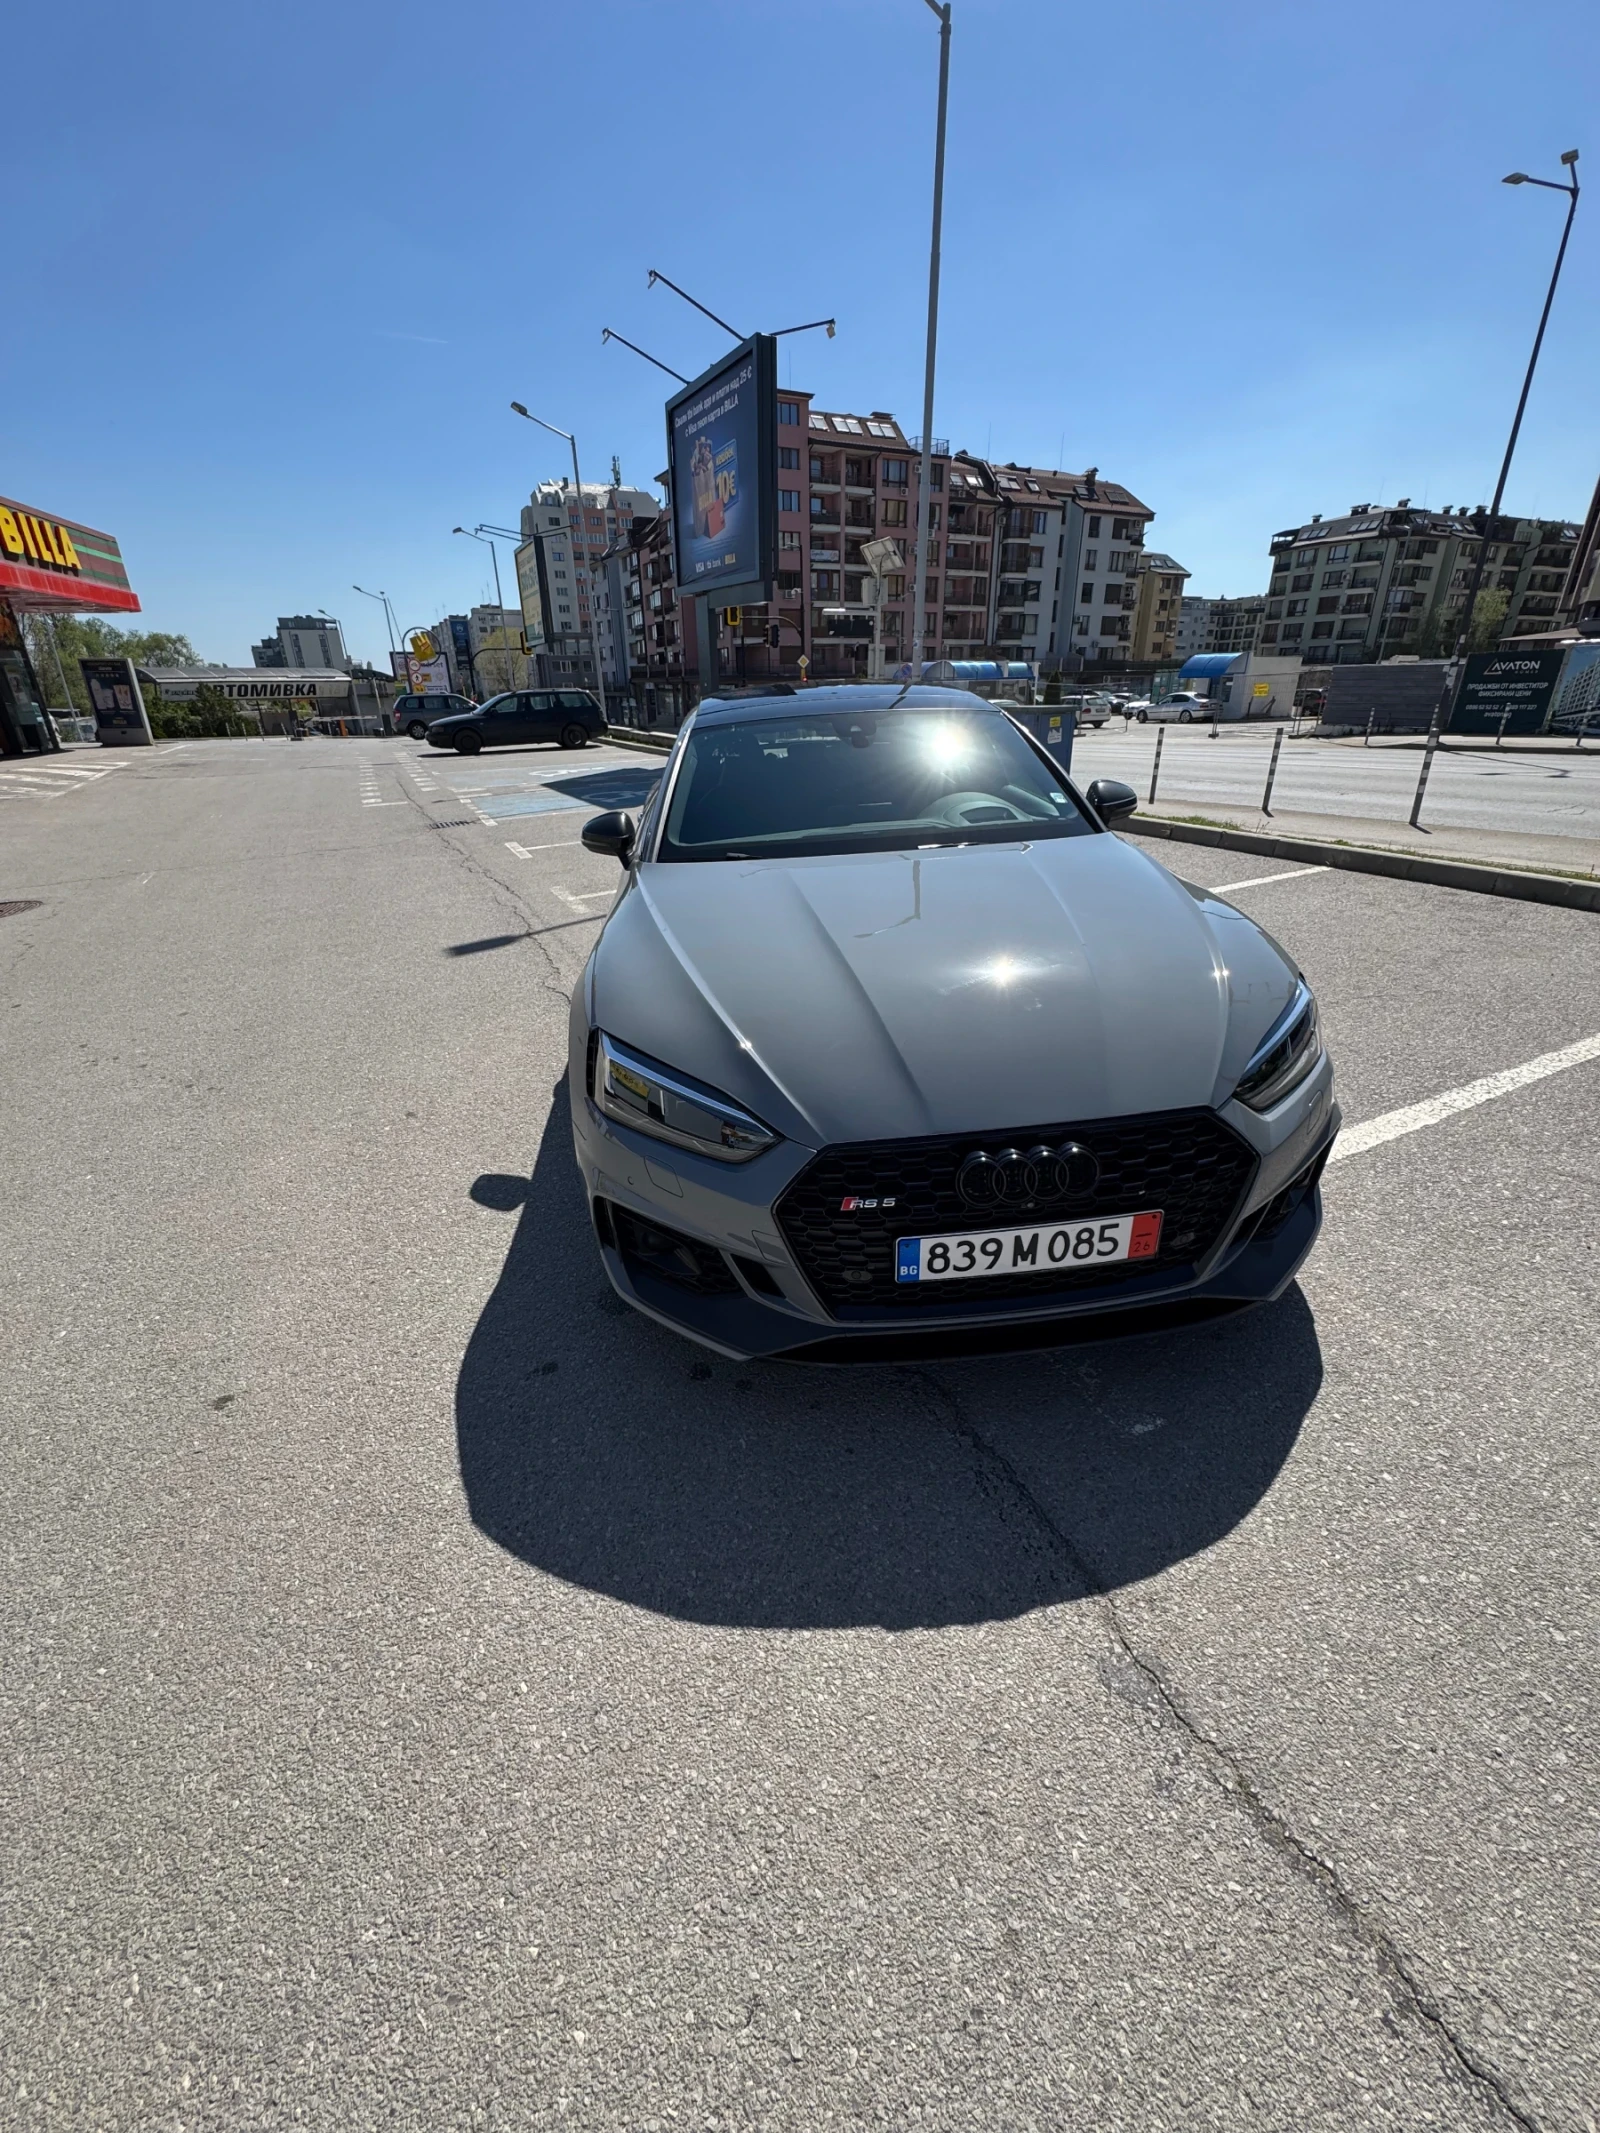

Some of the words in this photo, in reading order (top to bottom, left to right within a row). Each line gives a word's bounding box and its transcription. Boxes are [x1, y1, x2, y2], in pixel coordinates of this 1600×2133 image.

[693, 400, 703, 416] bank
[716, 383, 729, 401] плати
[730, 377, 740, 390] над
[740, 369, 747, 385] 25
[747, 365, 753, 379] €
[688, 422, 698, 436] Visa
[708, 407, 720, 422] карта
[724, 393, 739, 412] BILLA
[716, 470, 736, 504] 10€
[0, 505, 82, 570] BILLA
[695, 561, 705, 573] VISA
[712, 556, 722, 568] bank
[1491, 660, 1541, 671] AVATON
[211, 683, 317, 698] ВТОМИВКА
[1467, 683, 1500, 691] ПРОДАЖБИ
[1509, 682, 1549, 690] ИНВЕСТИТОР
[1515, 690, 1532, 698] ЦЕНИ
[850, 1198, 877, 1209] RS
[882, 1197, 896, 1207] 5
[900, 1265, 918, 1276] BG
[927, 1238, 1003, 1274] 839
[1012, 1233, 1039, 1267] M
[1048, 1223, 1120, 1264] 085
[1133, 1241, 1150, 1253] 26
